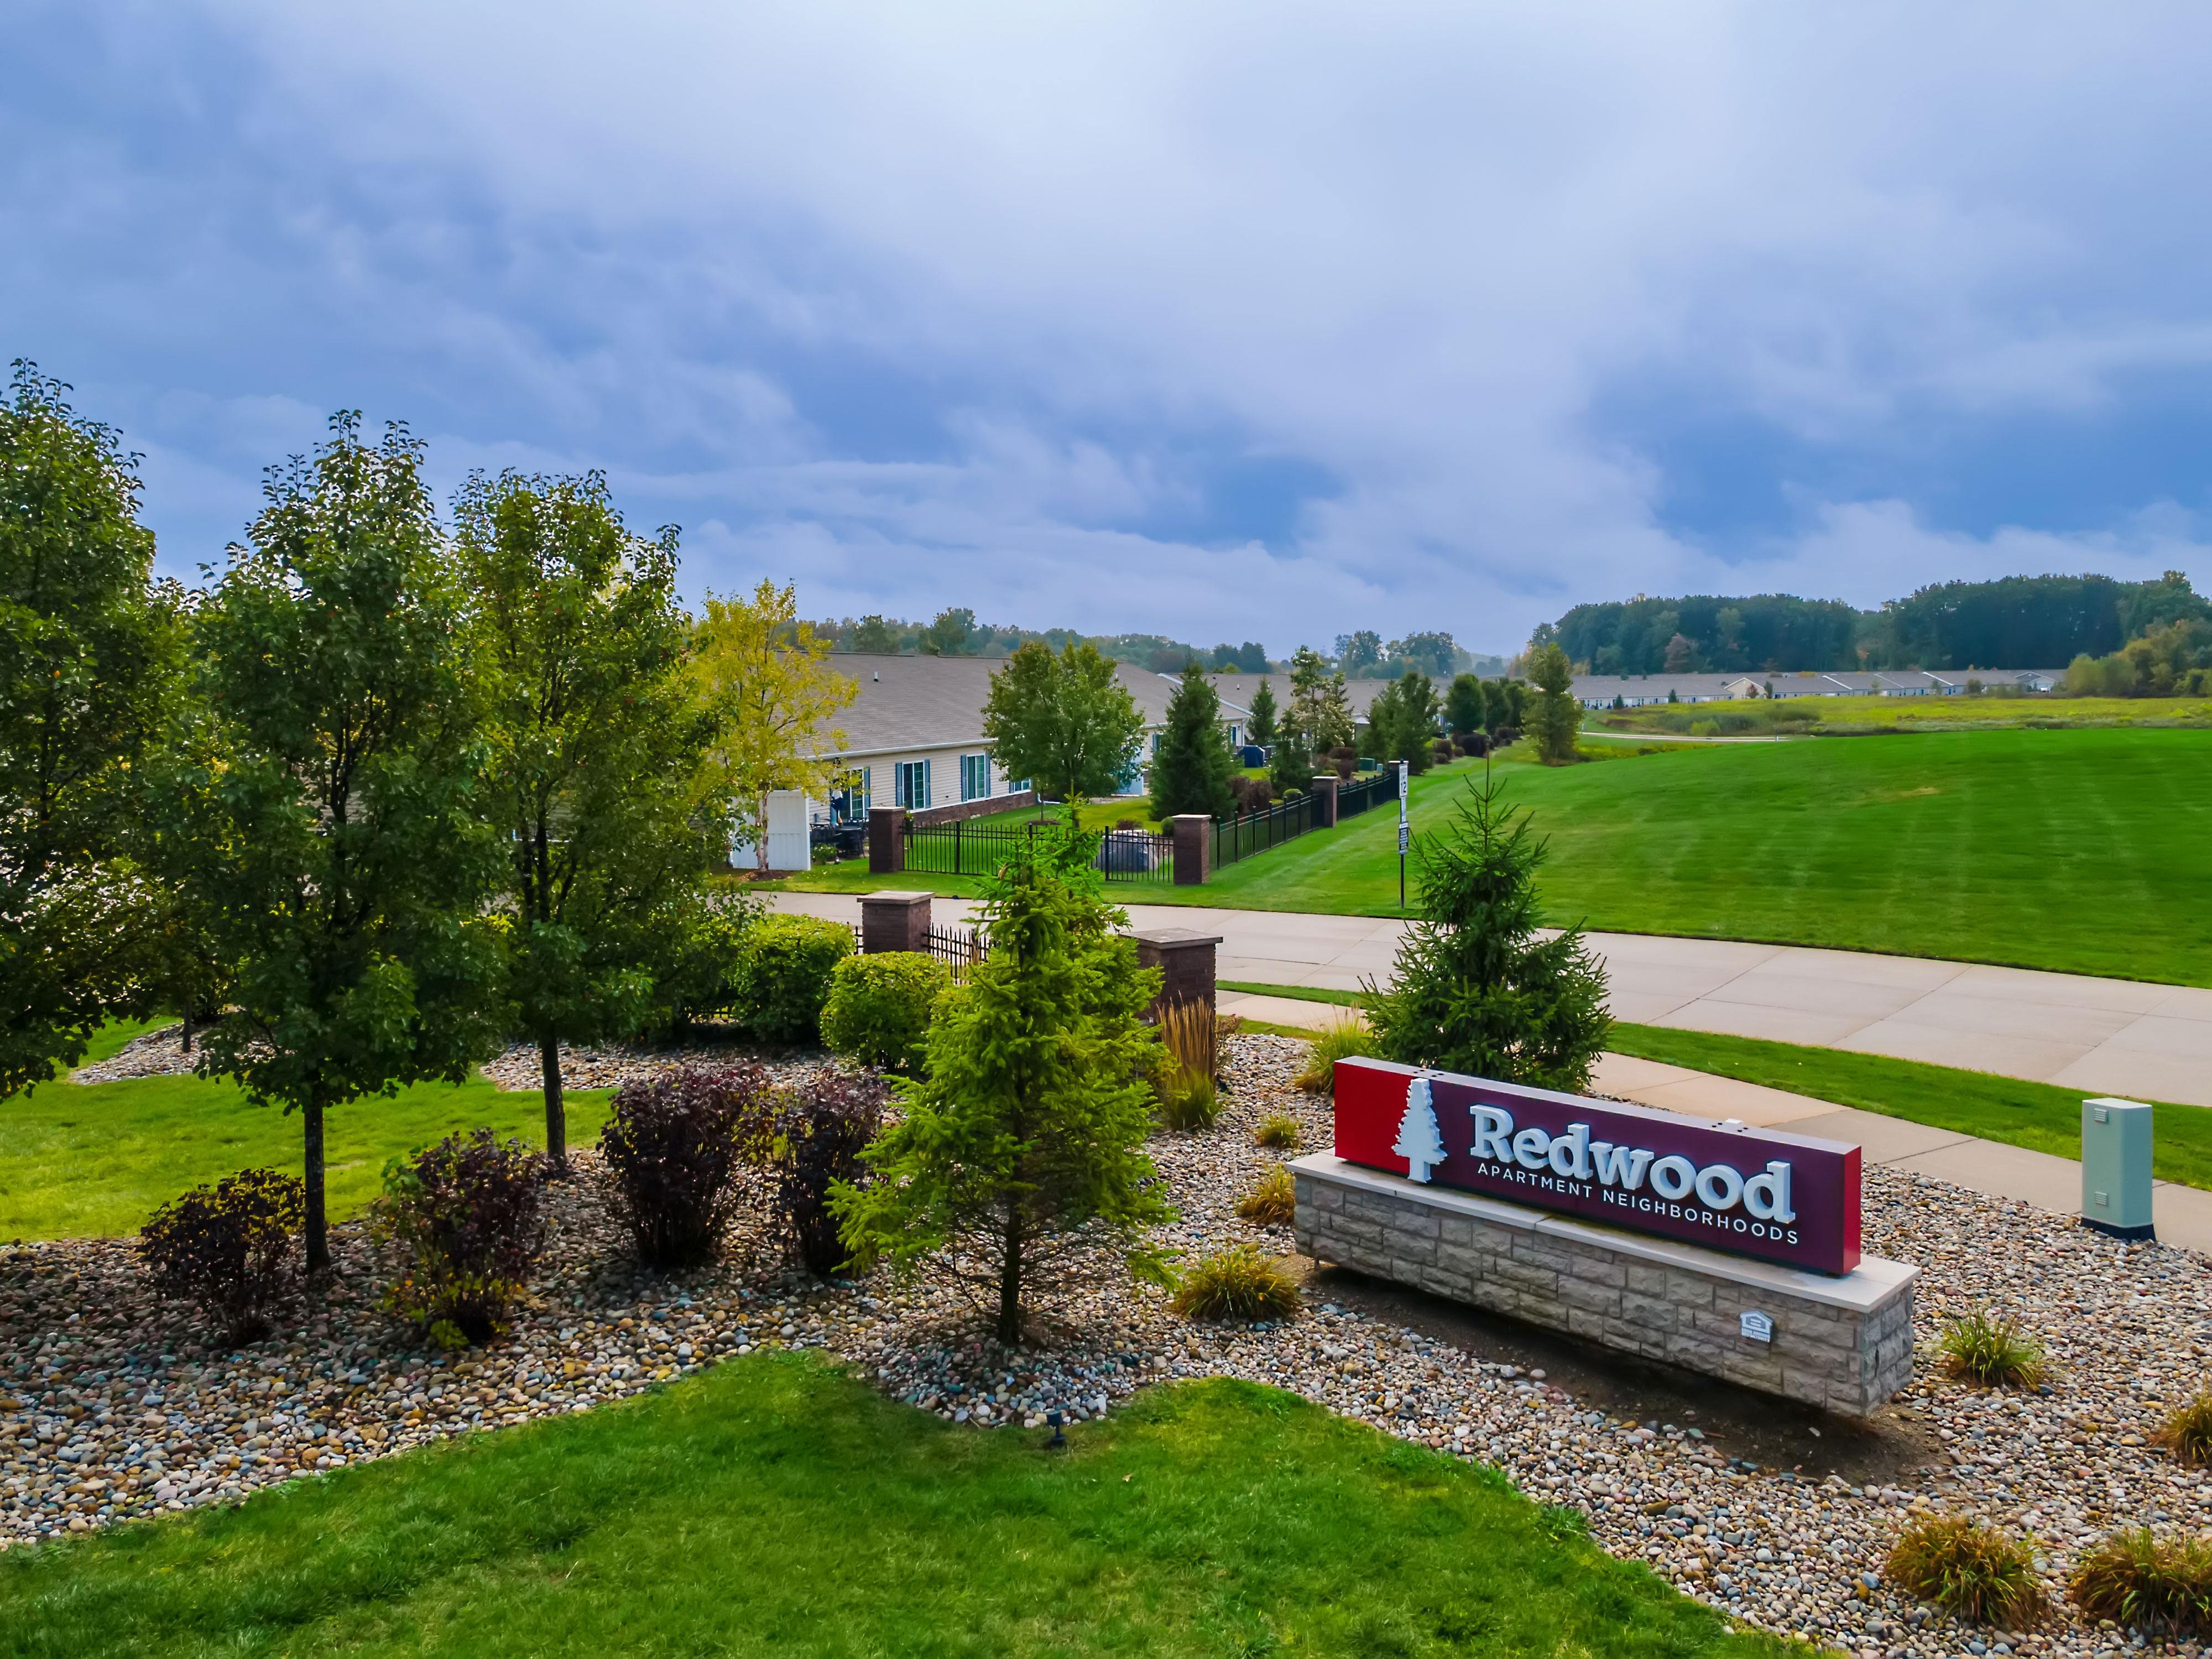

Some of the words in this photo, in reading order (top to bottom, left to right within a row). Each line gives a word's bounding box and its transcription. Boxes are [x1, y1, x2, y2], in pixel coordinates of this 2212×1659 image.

[1401, 781, 1407, 794] 12
[1470, 1104, 1796, 1224] Redwood
[1478, 1162, 1592, 1198] APARTMENT
[1603, 1190, 1798, 1244] NEIGHBORHOODS
